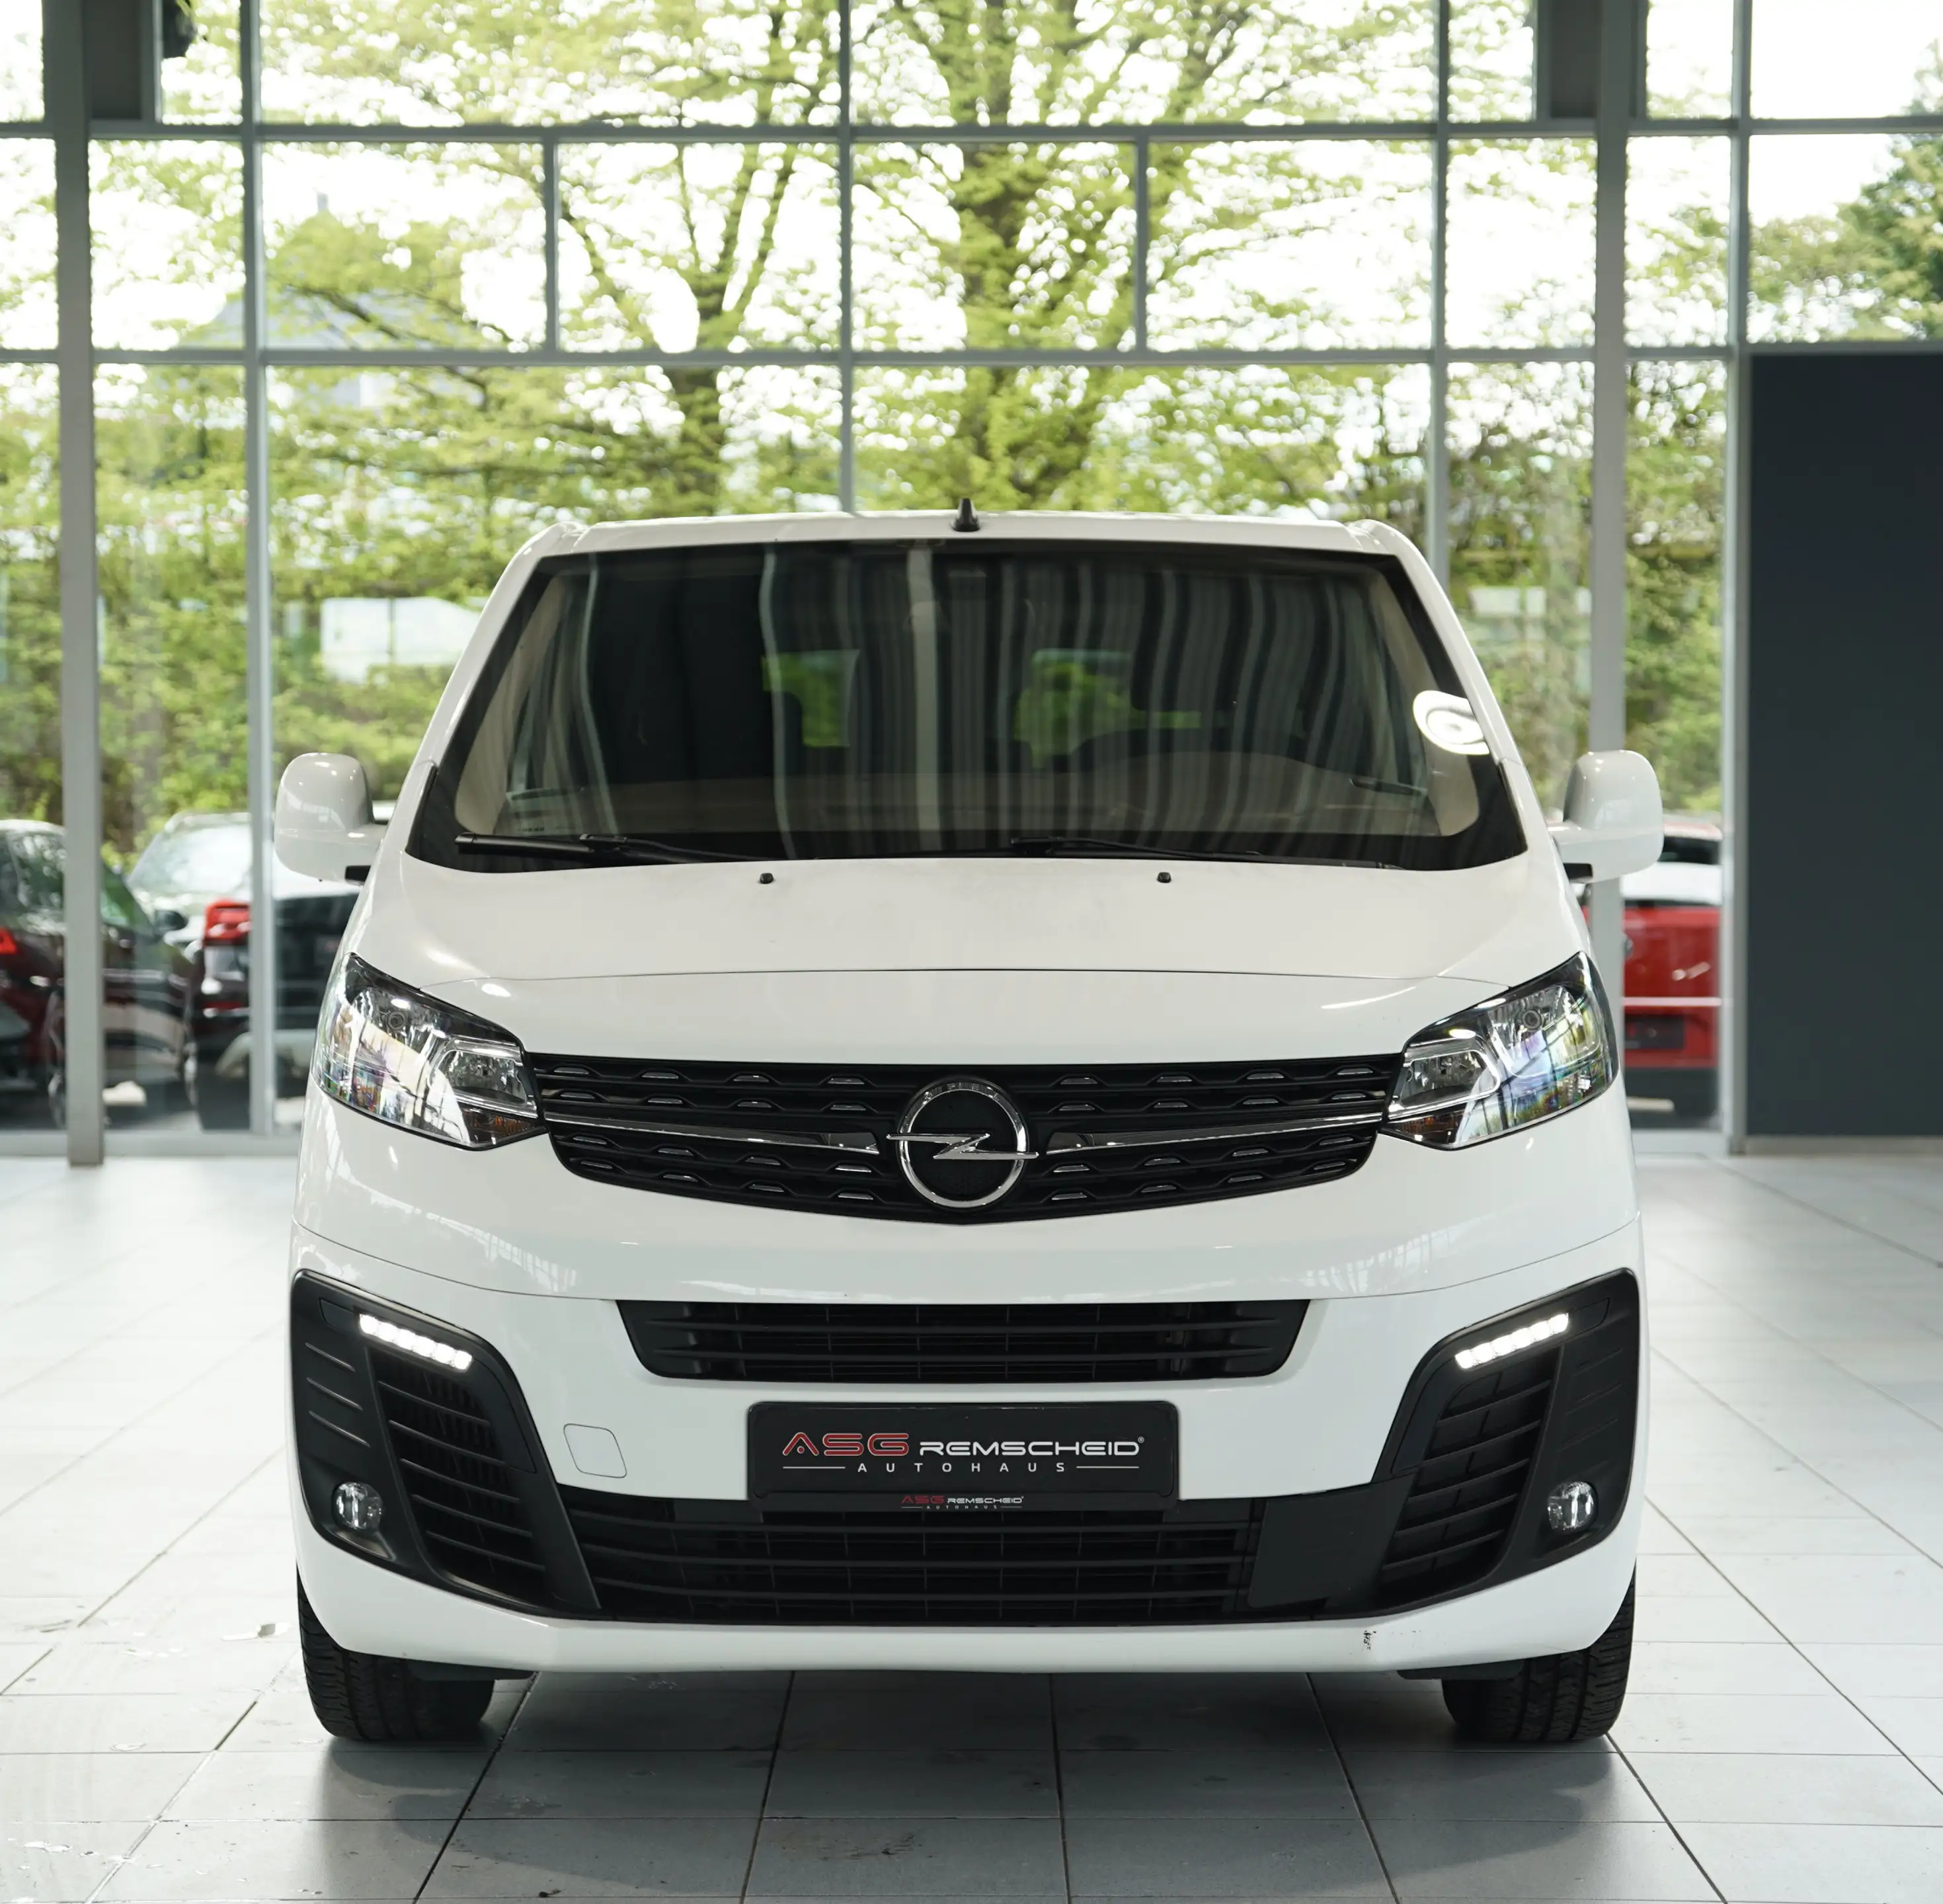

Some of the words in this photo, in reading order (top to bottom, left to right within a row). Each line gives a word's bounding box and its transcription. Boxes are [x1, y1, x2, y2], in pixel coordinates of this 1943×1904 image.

[782, 1431, 910, 1456] ASG
[857, 1462, 1065, 1473] AUTOHAUS
[901, 1495, 945, 1504] ASG
